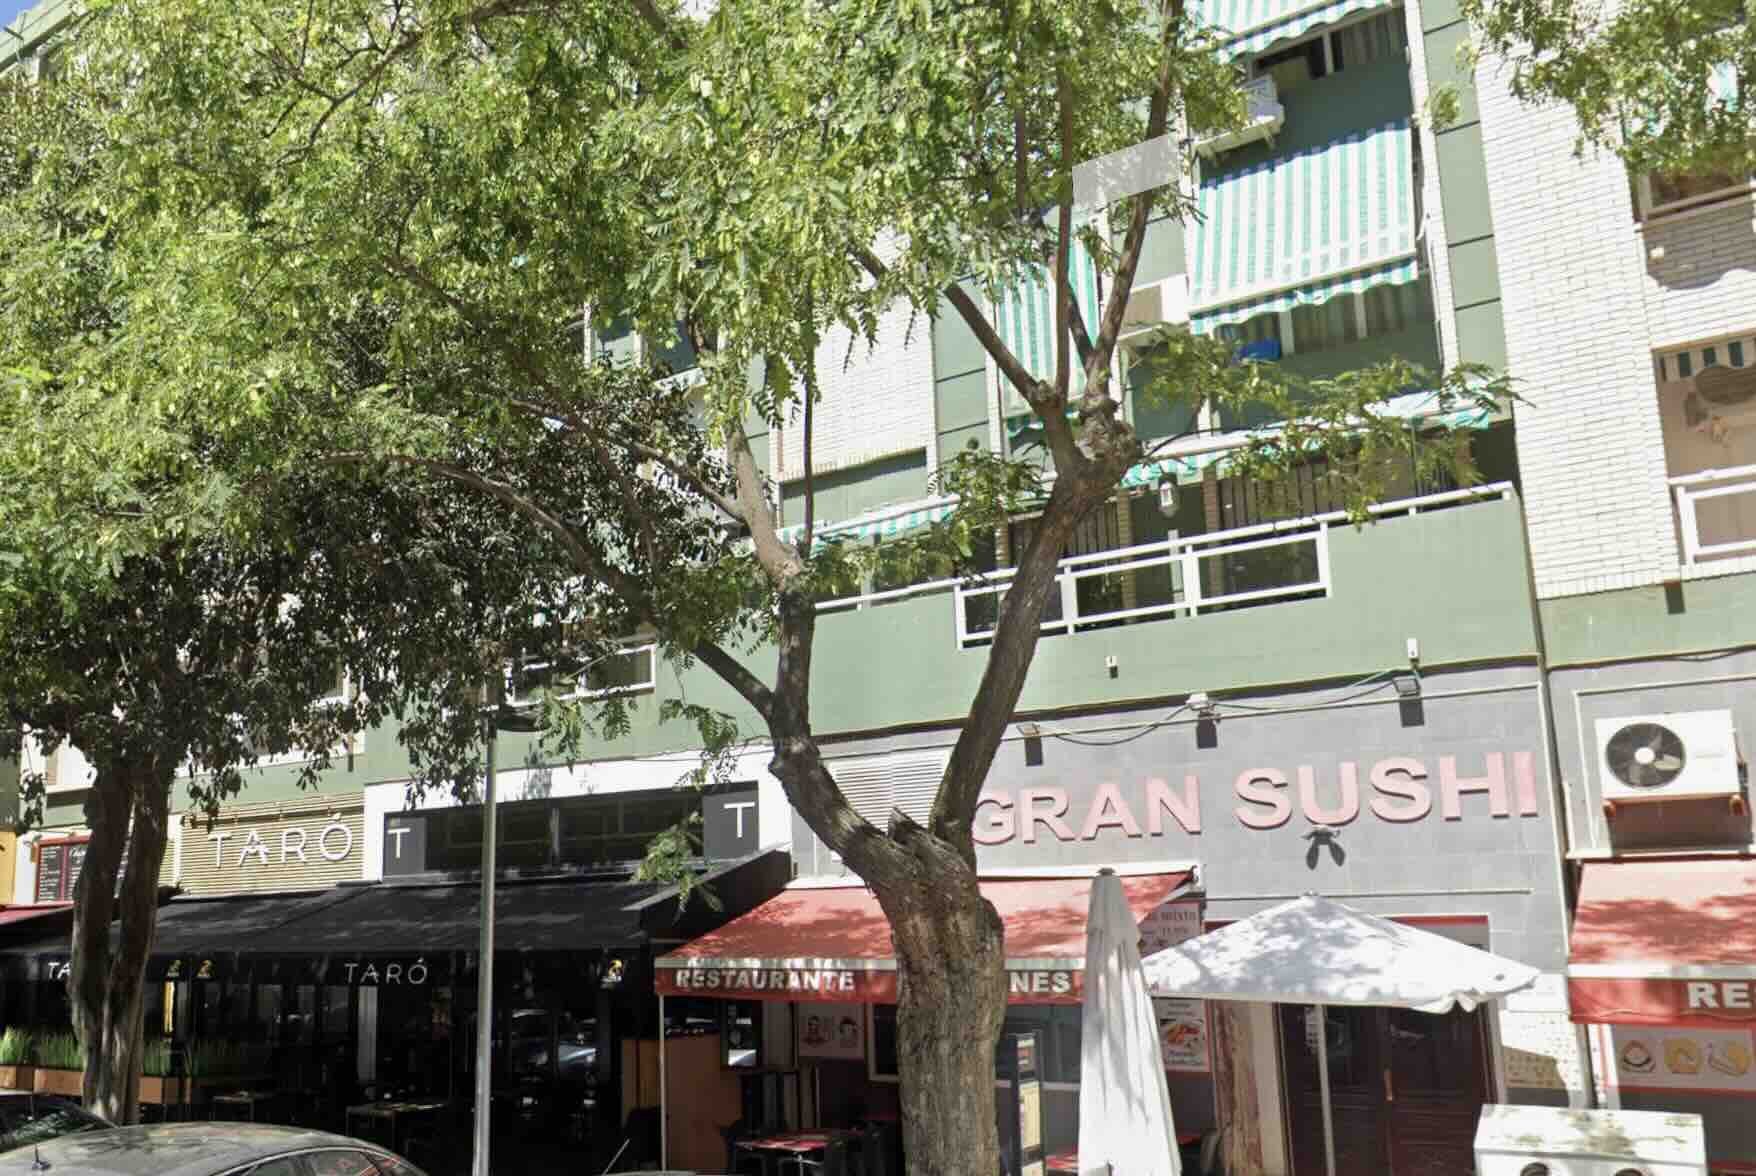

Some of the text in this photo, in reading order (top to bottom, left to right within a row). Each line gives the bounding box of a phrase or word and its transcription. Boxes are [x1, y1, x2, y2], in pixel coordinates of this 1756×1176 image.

[970, 750, 1539, 846] GRAN SUSHI
[724, 801, 756, 838] T
[208, 812, 353, 869] TARÓ
[387, 827, 411, 859] T
[48, 961, 73, 981] TA
[343, 956, 429, 985] TARÓ
[675, 967, 1072, 993] RESTAURANTE NES
[1687, 981, 1756, 1009] RE
